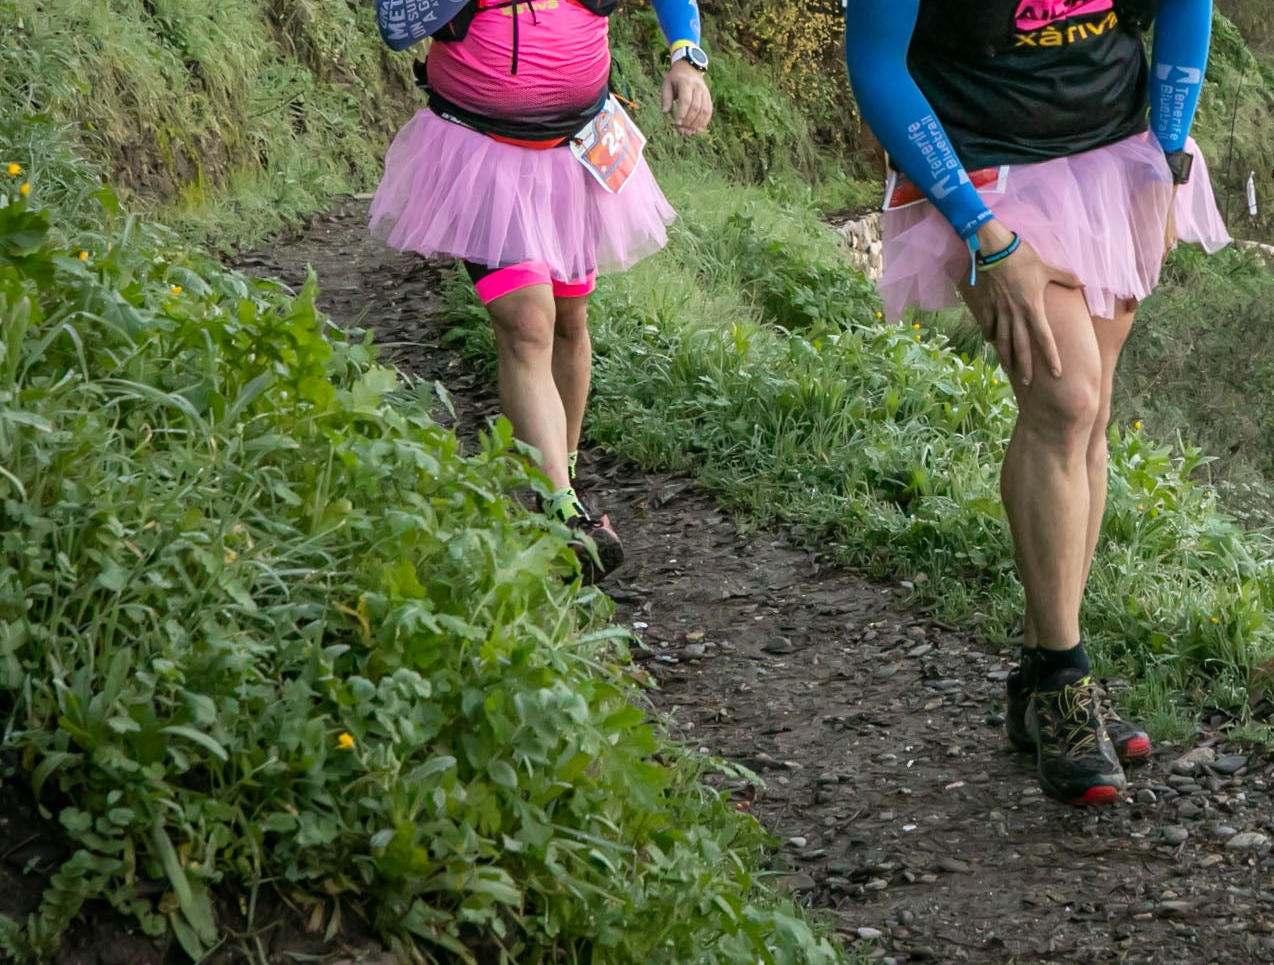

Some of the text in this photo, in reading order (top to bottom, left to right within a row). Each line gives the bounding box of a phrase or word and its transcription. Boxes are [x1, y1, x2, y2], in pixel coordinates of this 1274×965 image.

[410, 21, 426, 38] UN
[423, 11, 437, 22] A
[1170, 87, 1189, 141] Tenerife
[601, 120, 625, 157] 24
[907, 121, 946, 179] Tenerife
[921, 114, 958, 169] Bluetrail
